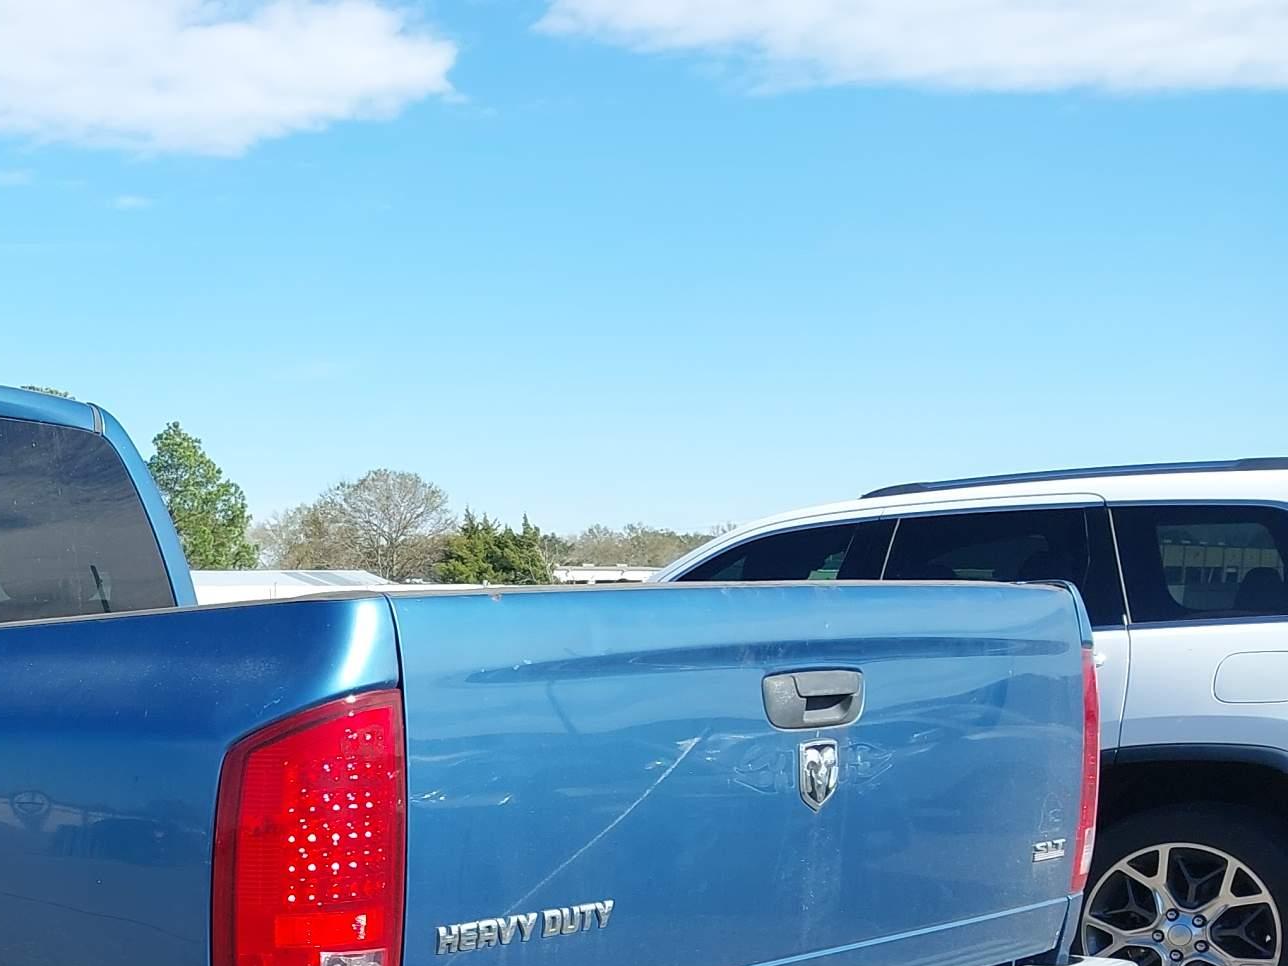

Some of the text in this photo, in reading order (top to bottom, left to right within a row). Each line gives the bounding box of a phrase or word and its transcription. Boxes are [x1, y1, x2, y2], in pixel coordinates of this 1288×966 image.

[1032, 838, 1066, 853] SLT
[436, 898, 616, 955] HEAVY DUTY
